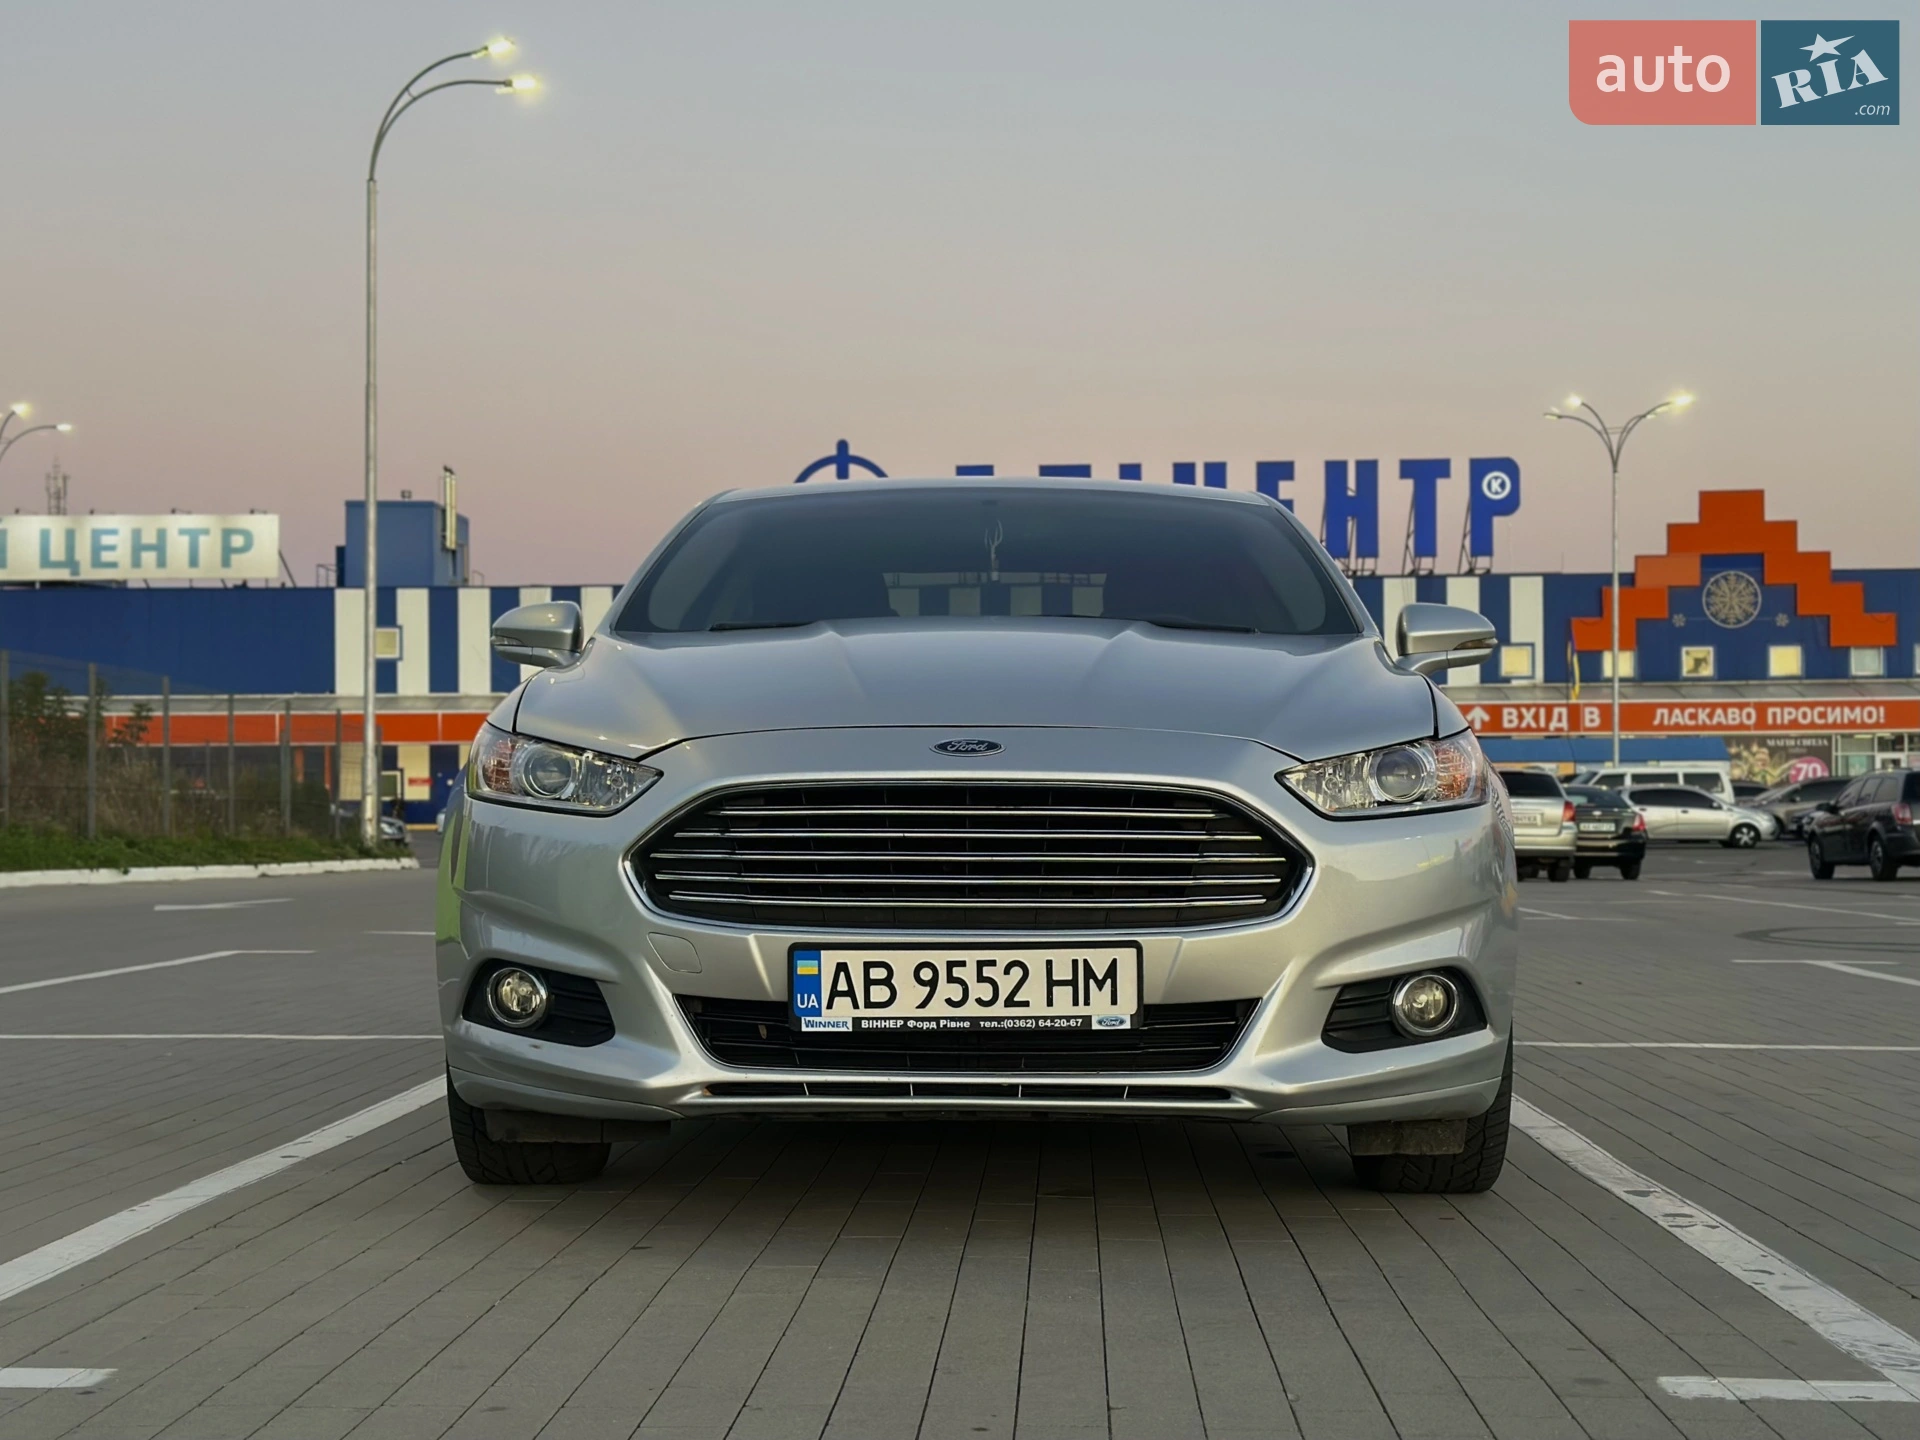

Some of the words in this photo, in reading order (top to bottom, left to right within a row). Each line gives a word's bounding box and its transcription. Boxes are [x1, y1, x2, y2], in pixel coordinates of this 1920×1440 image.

[39, 528, 255, 577] ЦЕНТР
[1502, 706, 1569, 732] ВХІД
[1583, 706, 1601, 729] В
[1652, 707, 1757, 726] ЛАСКАВО
[1766, 706, 1886, 725] ПРОСИМО!
[946, 739, 989, 752] Ford
[825, 959, 898, 1011] AB
[912, 958, 1031, 1010] 9552
[1045, 957, 1118, 1008] HM
[797, 993, 819, 1010] UA
[803, 1017, 850, 1030] WINNER
[861, 1019, 905, 1029] ВІННЕР
[906, 1020, 937, 1030] Форд
[939, 1019, 971, 1029] Рівне
[1038, 1018, 1083, 1028] 64-20-67
